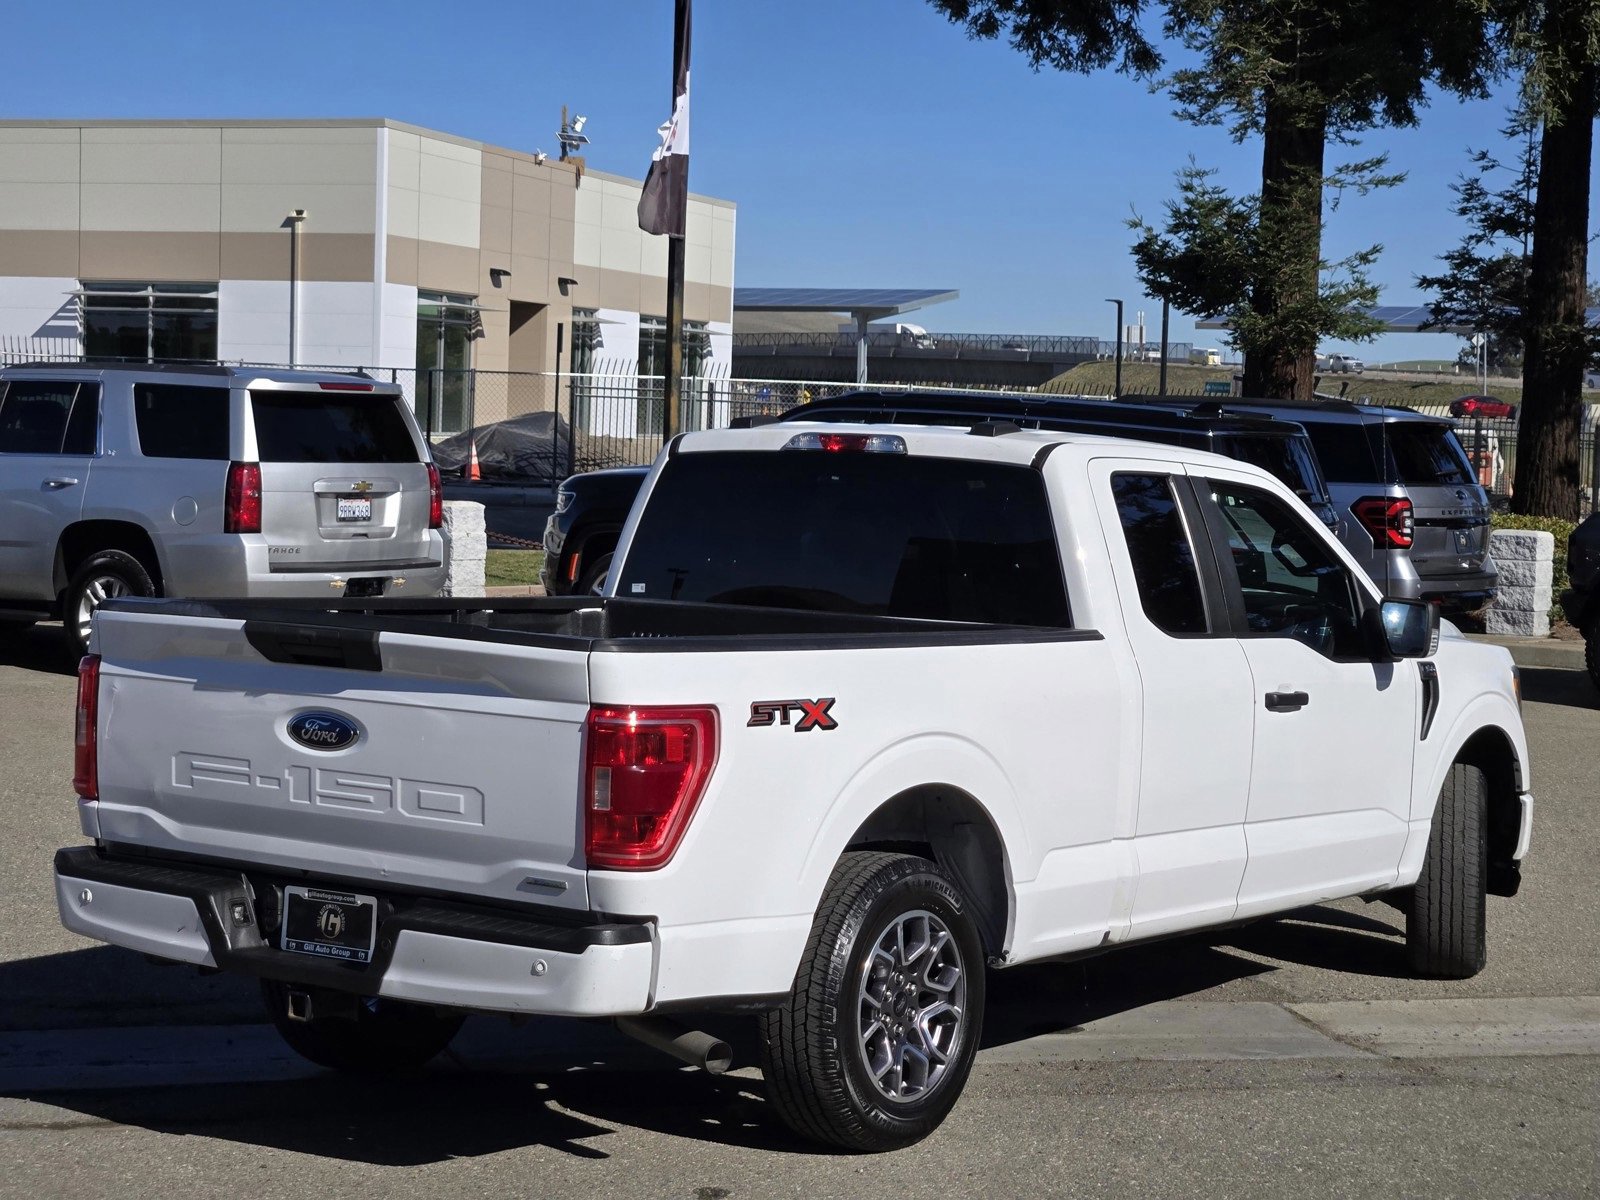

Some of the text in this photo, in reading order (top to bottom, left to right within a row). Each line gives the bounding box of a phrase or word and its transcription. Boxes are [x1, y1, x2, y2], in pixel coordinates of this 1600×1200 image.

[1441, 509, 1488, 517] EXPEDI
[746, 697, 839, 733] STX
[301, 717, 340, 743] Ford
[171, 750, 486, 827] F-150
[303, 943, 315, 951] Gill
[315, 944, 330, 954] Auto
[331, 946, 351, 957] Group
